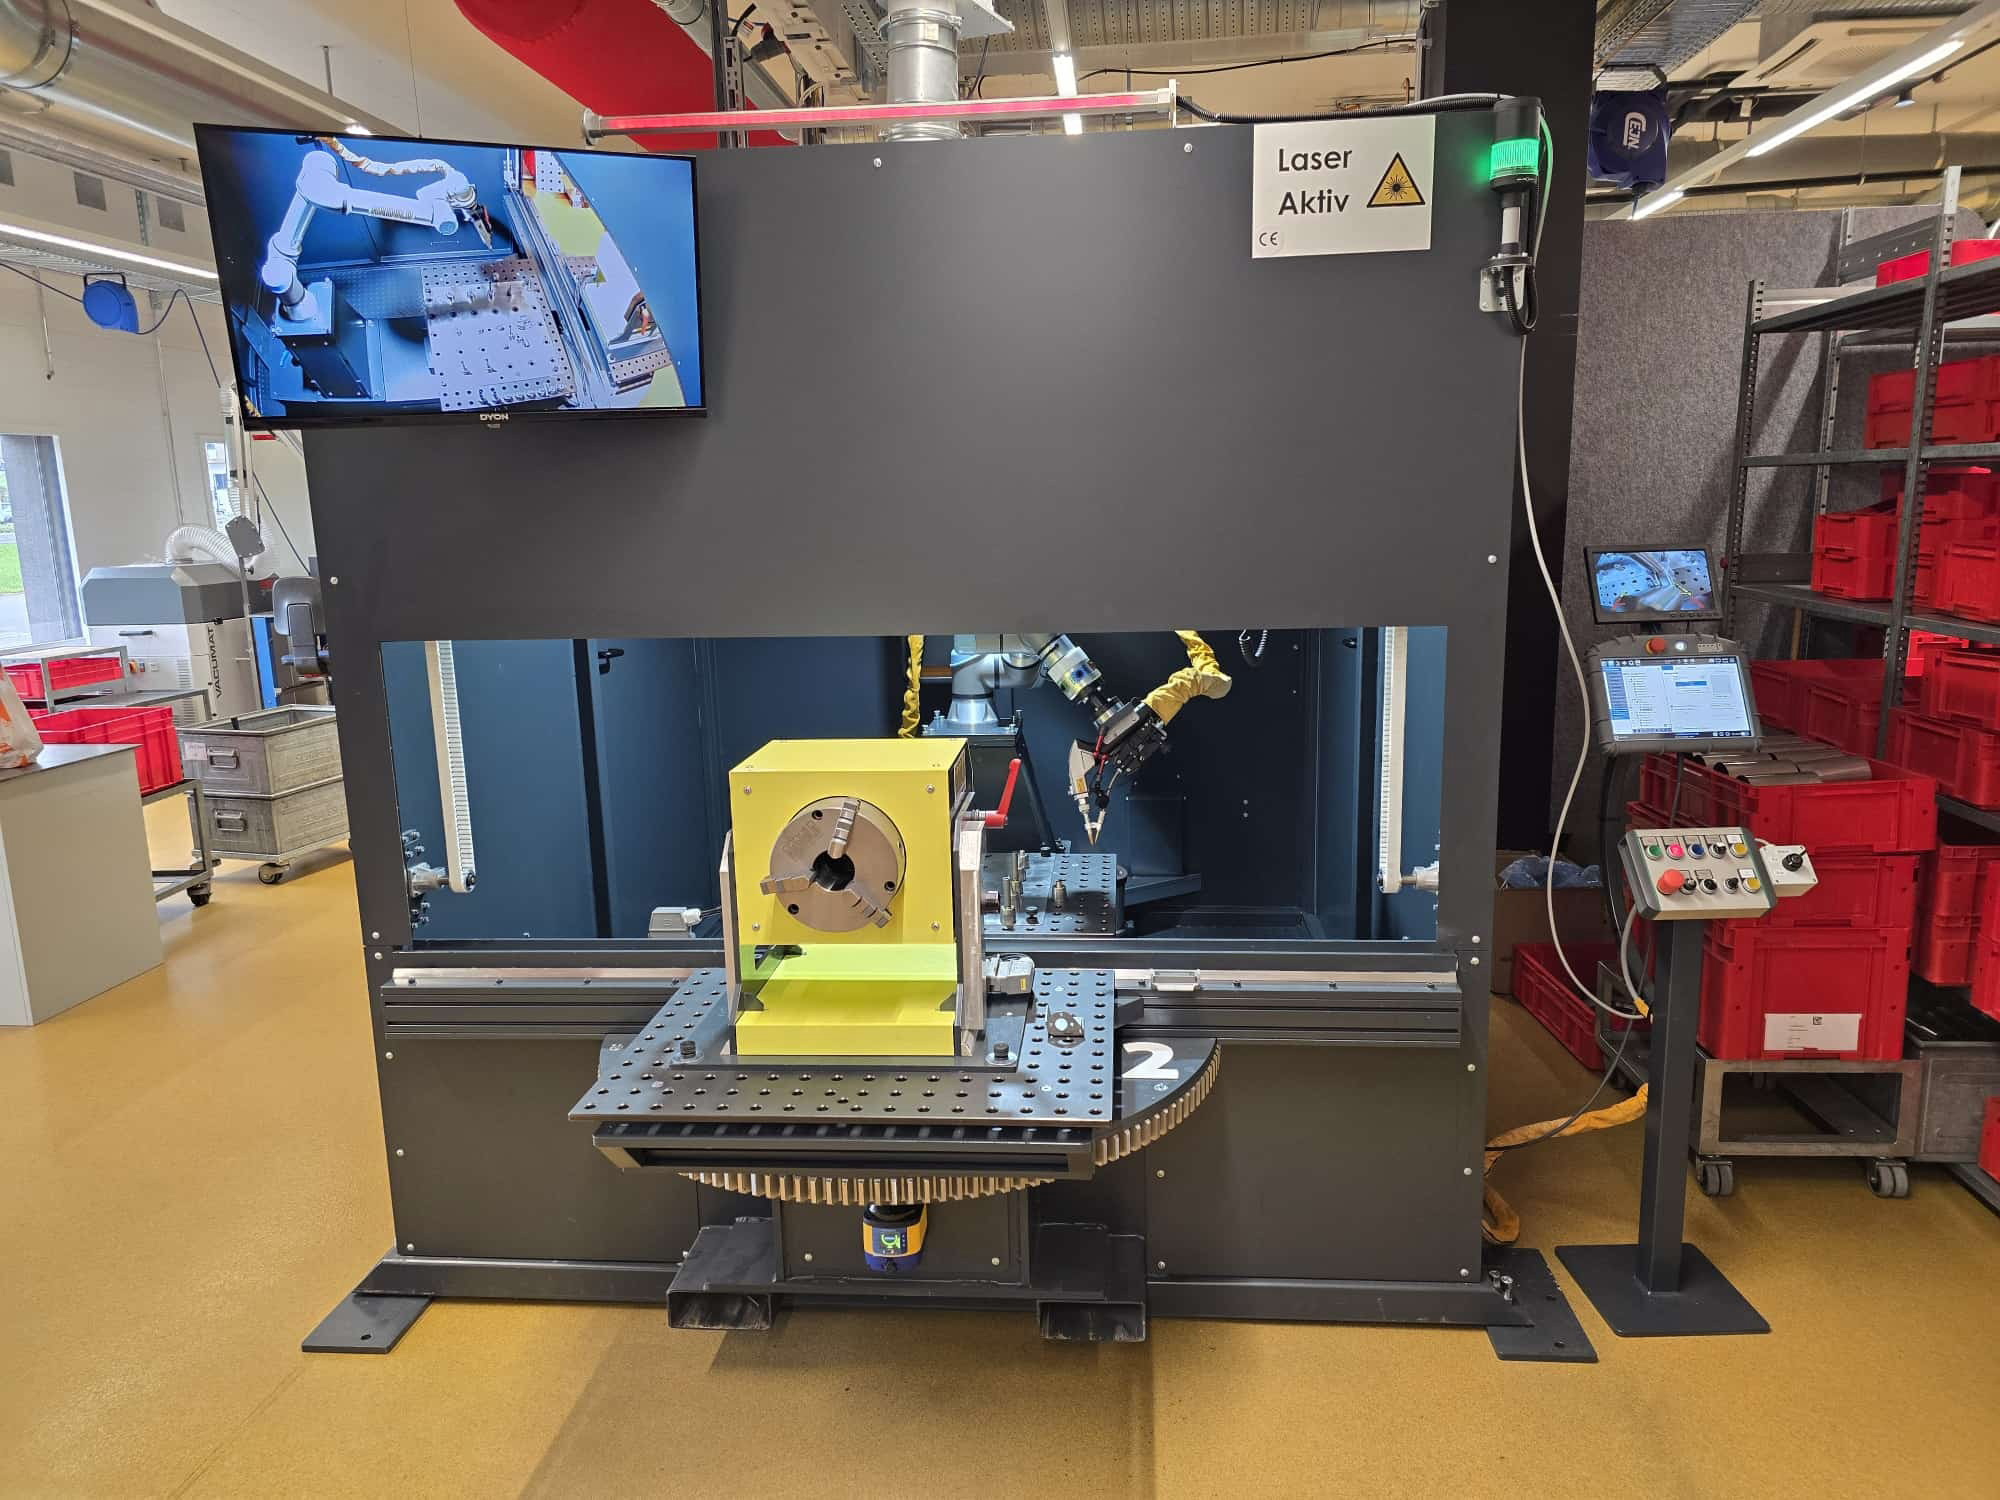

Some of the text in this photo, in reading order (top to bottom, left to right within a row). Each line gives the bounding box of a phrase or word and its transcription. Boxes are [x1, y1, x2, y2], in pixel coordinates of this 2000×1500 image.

[1278, 148, 1353, 173] Laser
[1278, 189, 1350, 216] Aktiv
[1259, 231, 1279, 247] CE
[207, 626, 222, 699] VACUMAT
[1121, 1041, 1180, 1080] 2
